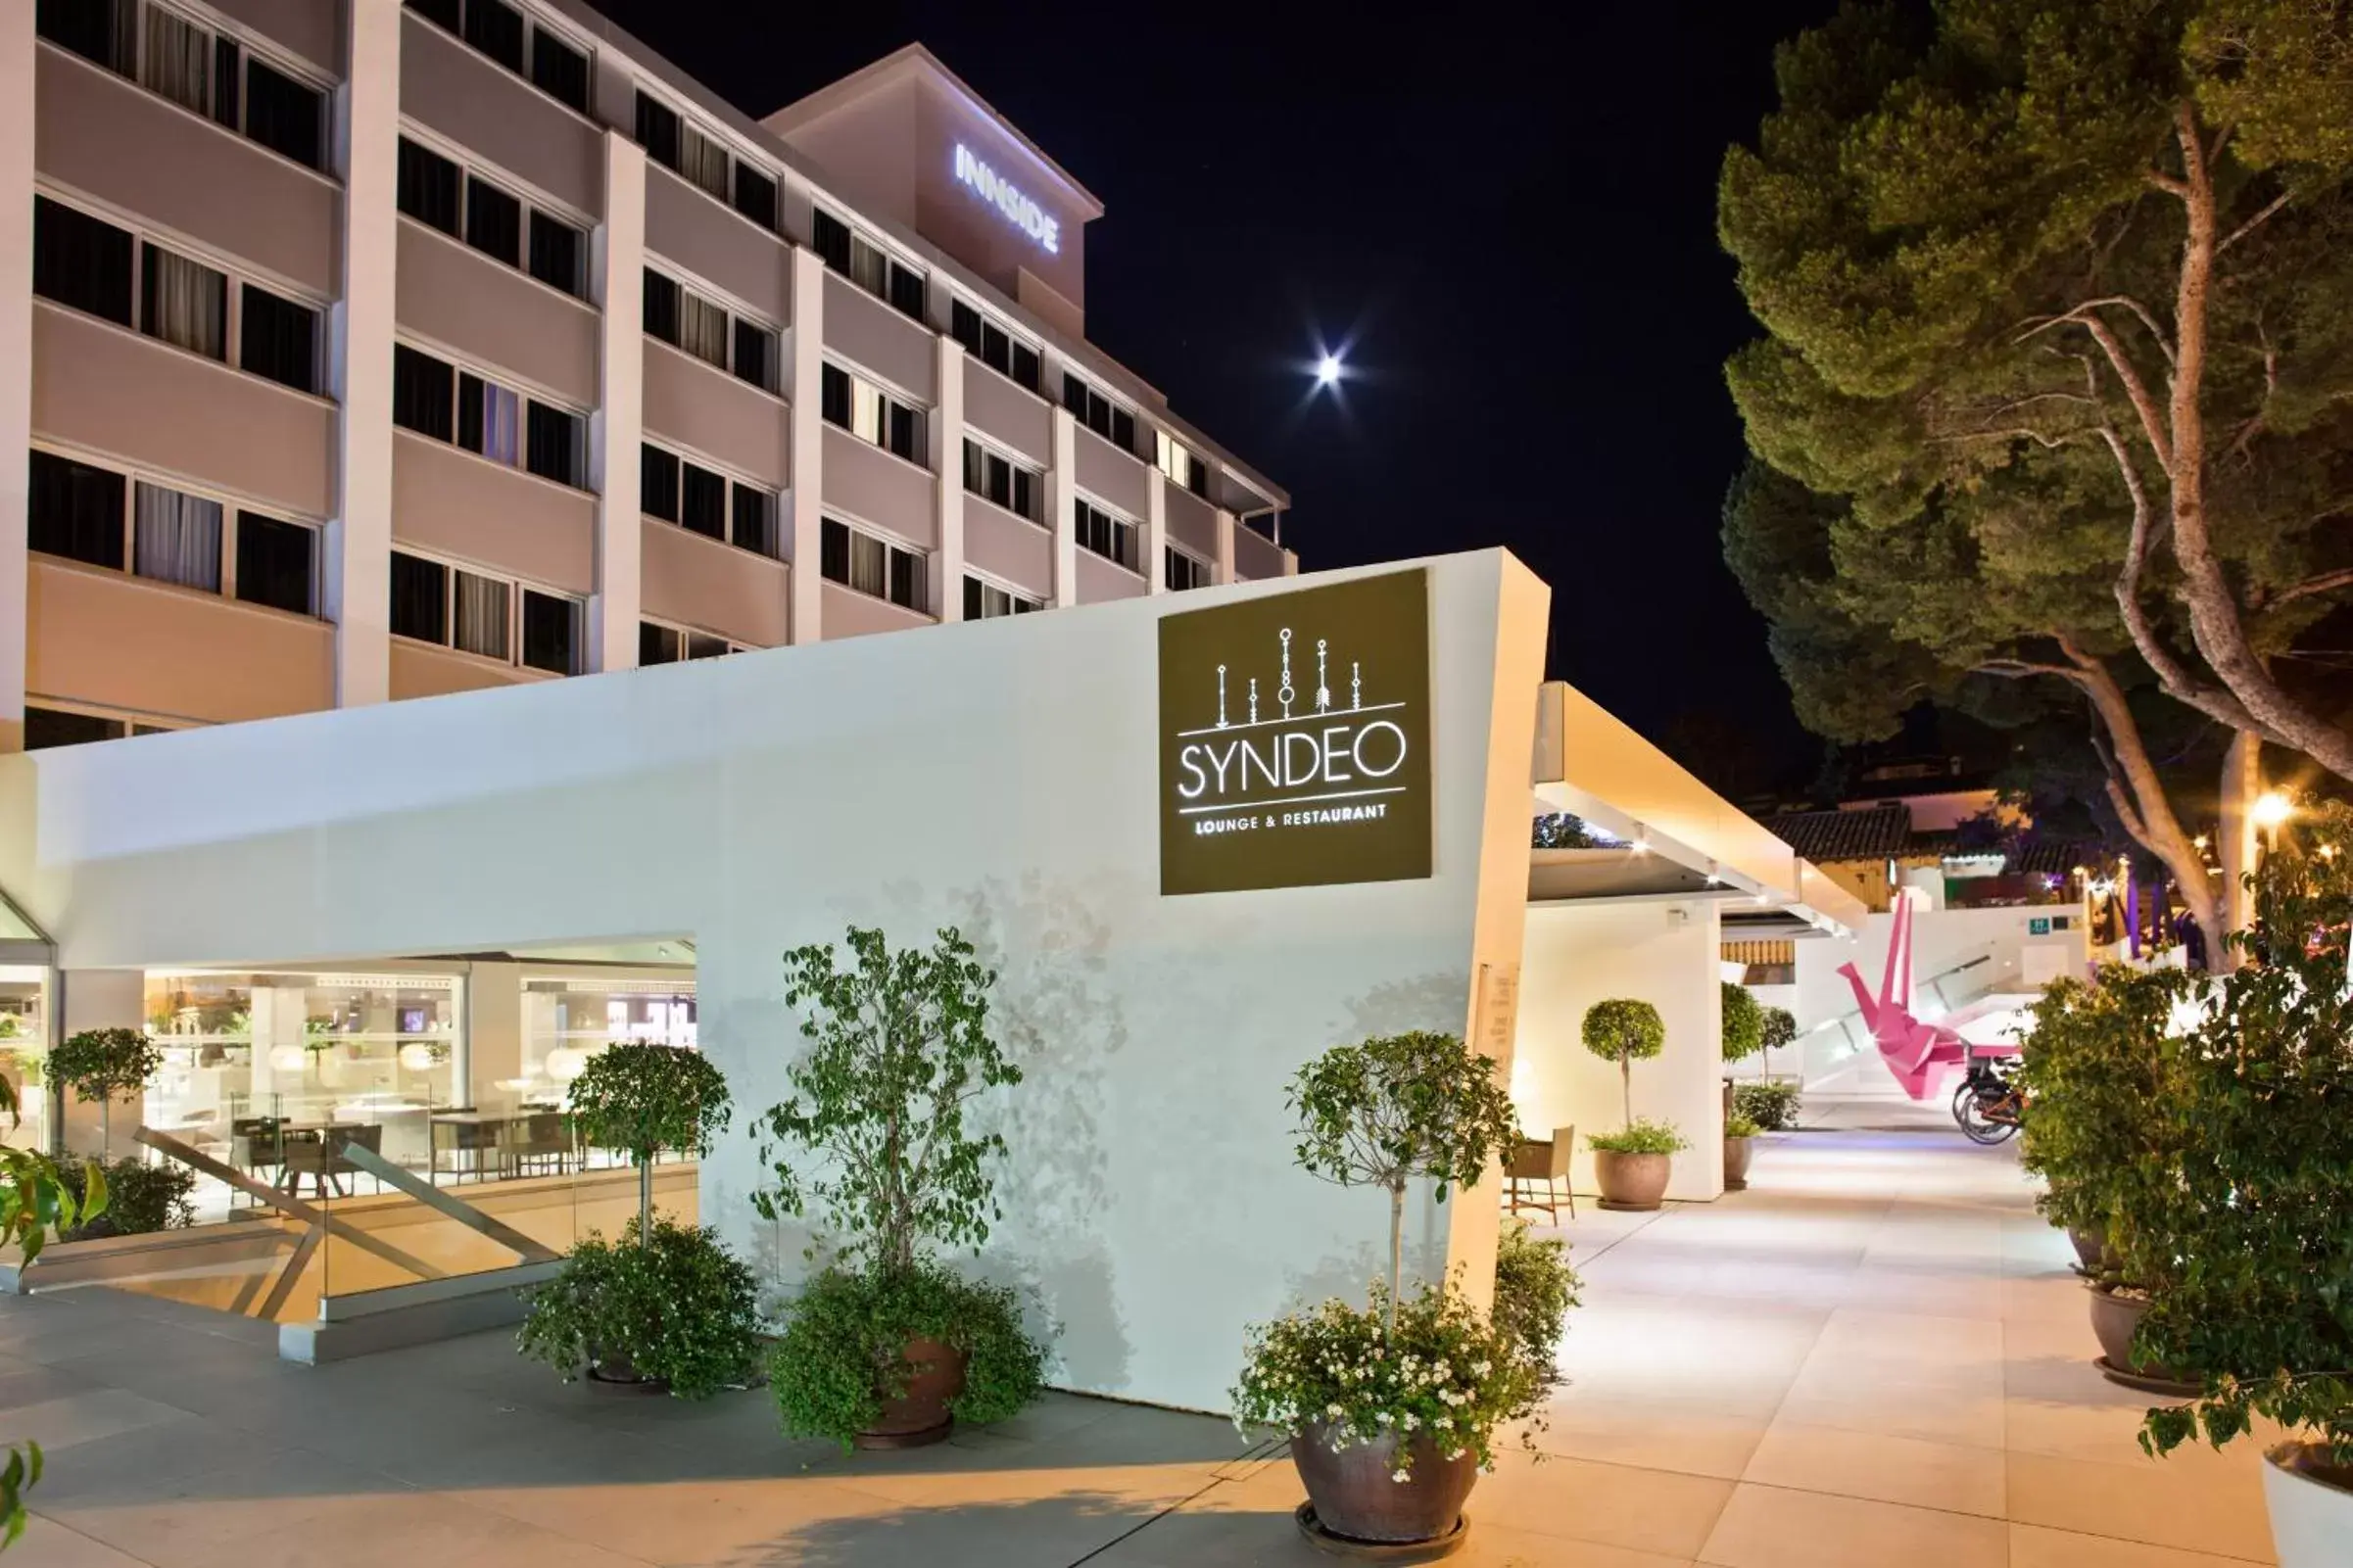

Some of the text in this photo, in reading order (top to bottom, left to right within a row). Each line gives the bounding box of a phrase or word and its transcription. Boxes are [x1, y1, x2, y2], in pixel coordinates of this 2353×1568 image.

[956, 144, 1058, 253] INNSIDE
[1178, 721, 1406, 797] SYNDEO
[1195, 804, 1386, 834] LOUNGE & RESTAURANT
